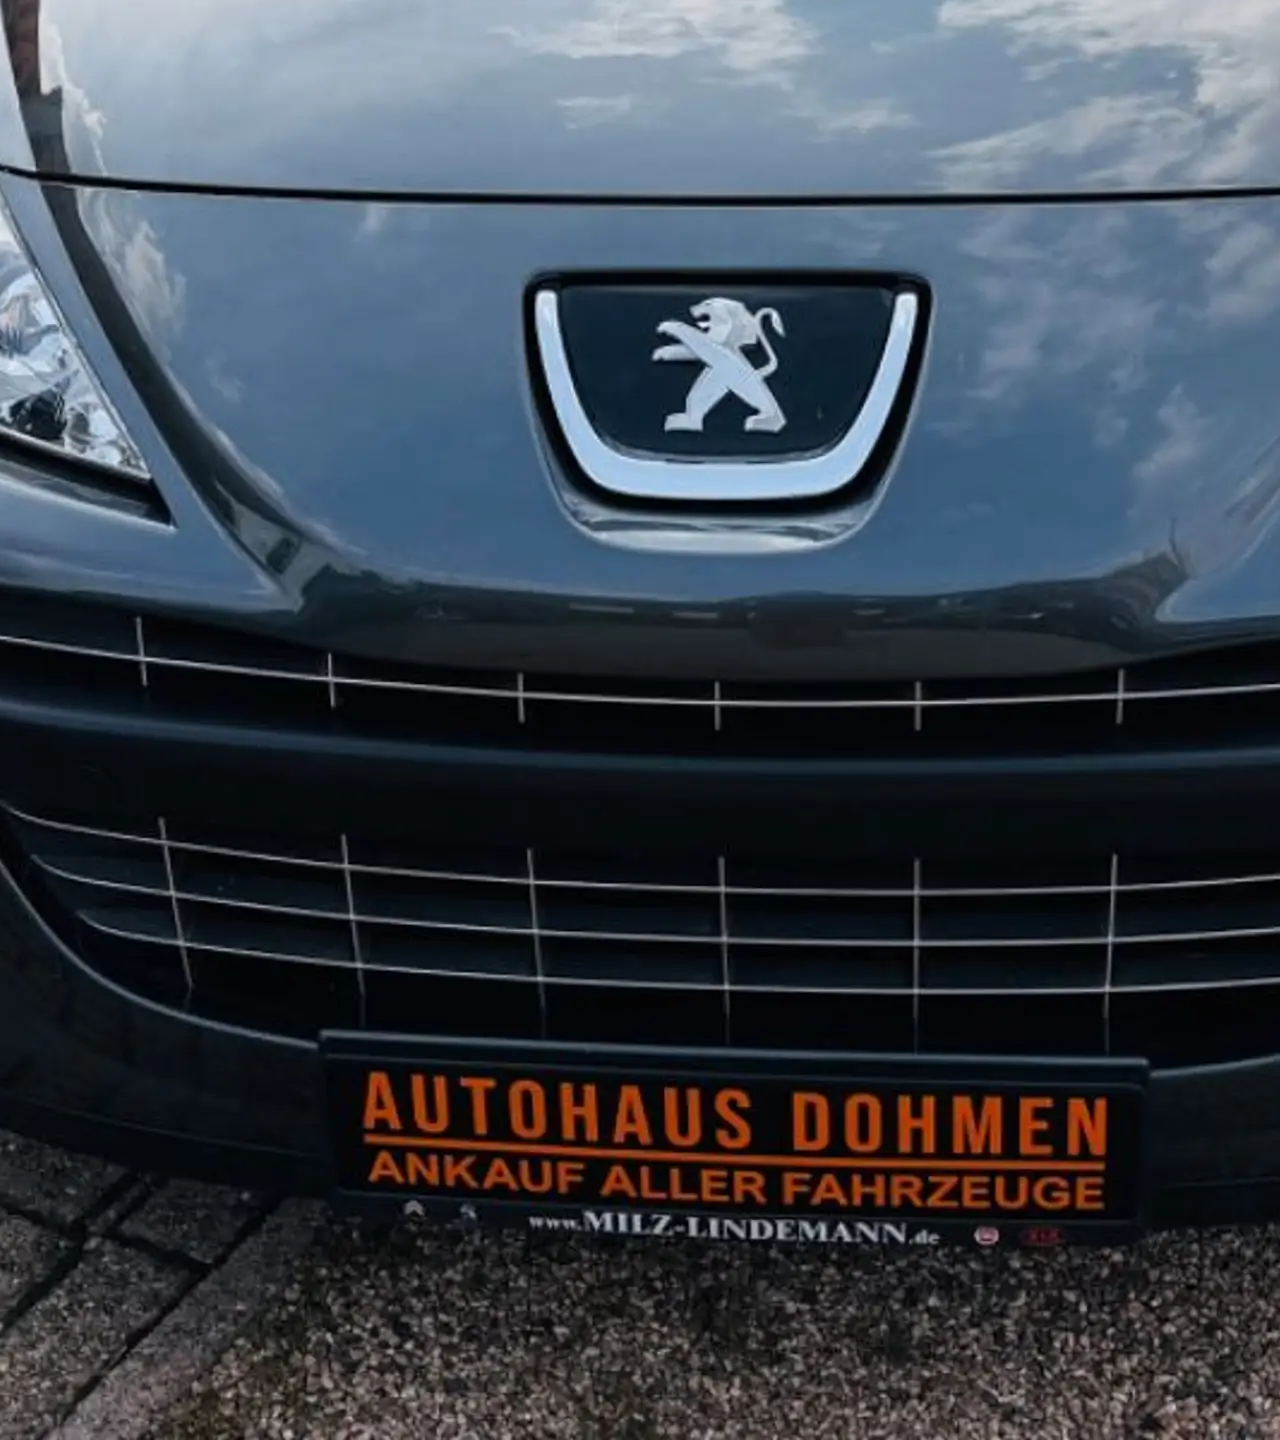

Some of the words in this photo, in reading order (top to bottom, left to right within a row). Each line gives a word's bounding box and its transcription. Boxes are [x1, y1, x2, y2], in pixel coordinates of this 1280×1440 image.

[363, 1069, 753, 1151] AUTOHAUS
[792, 1090, 1109, 1157] DOHMEN
[368, 1148, 586, 1194] ANKAUF
[600, 1163, 768, 1205] ALLER
[782, 1170, 1106, 1210] FAHRZEUGE
[528, 1208, 941, 1248] www.MILZ-LINDEMANN.de
